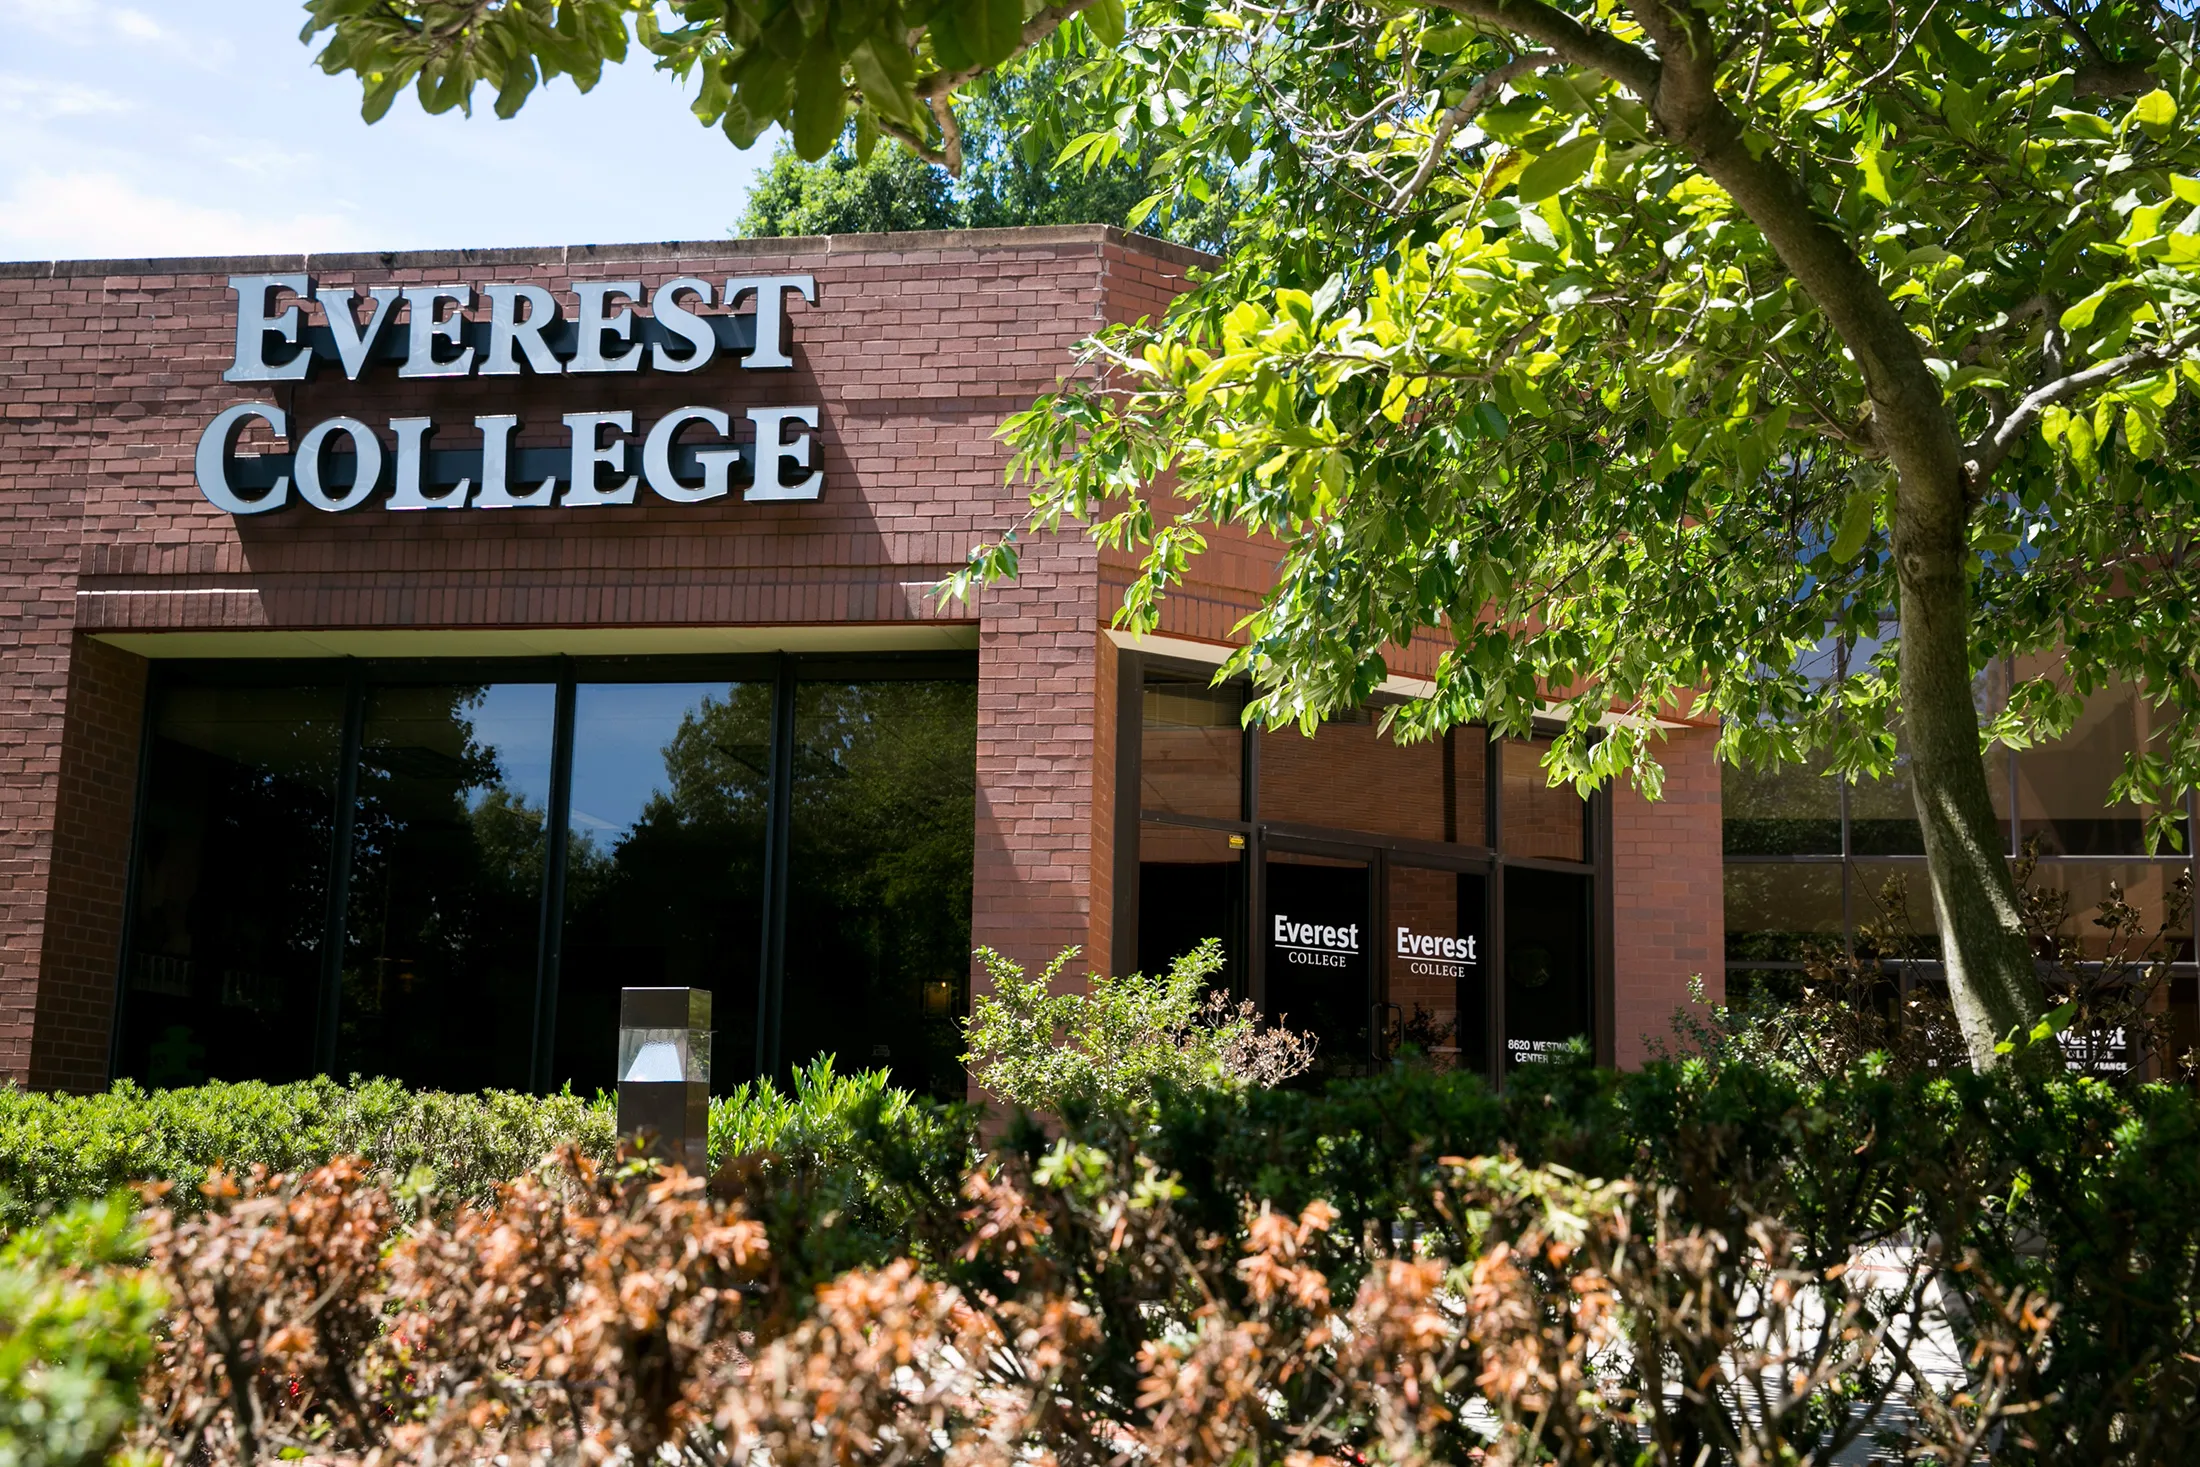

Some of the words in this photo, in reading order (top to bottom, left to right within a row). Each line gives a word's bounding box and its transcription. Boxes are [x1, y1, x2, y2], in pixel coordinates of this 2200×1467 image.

[222, 274, 818, 383] EVEREST
[195, 400, 825, 515] COLLEGE
[1274, 914, 1359, 949] Everest
[1397, 926, 1477, 960] Everest
[1288, 951, 1347, 968] COLLEGE
[1410, 962, 1465, 977] COLLEGE
[1507, 1039, 1531, 1051] 8620
[1515, 1052, 1549, 1064] CENTER
